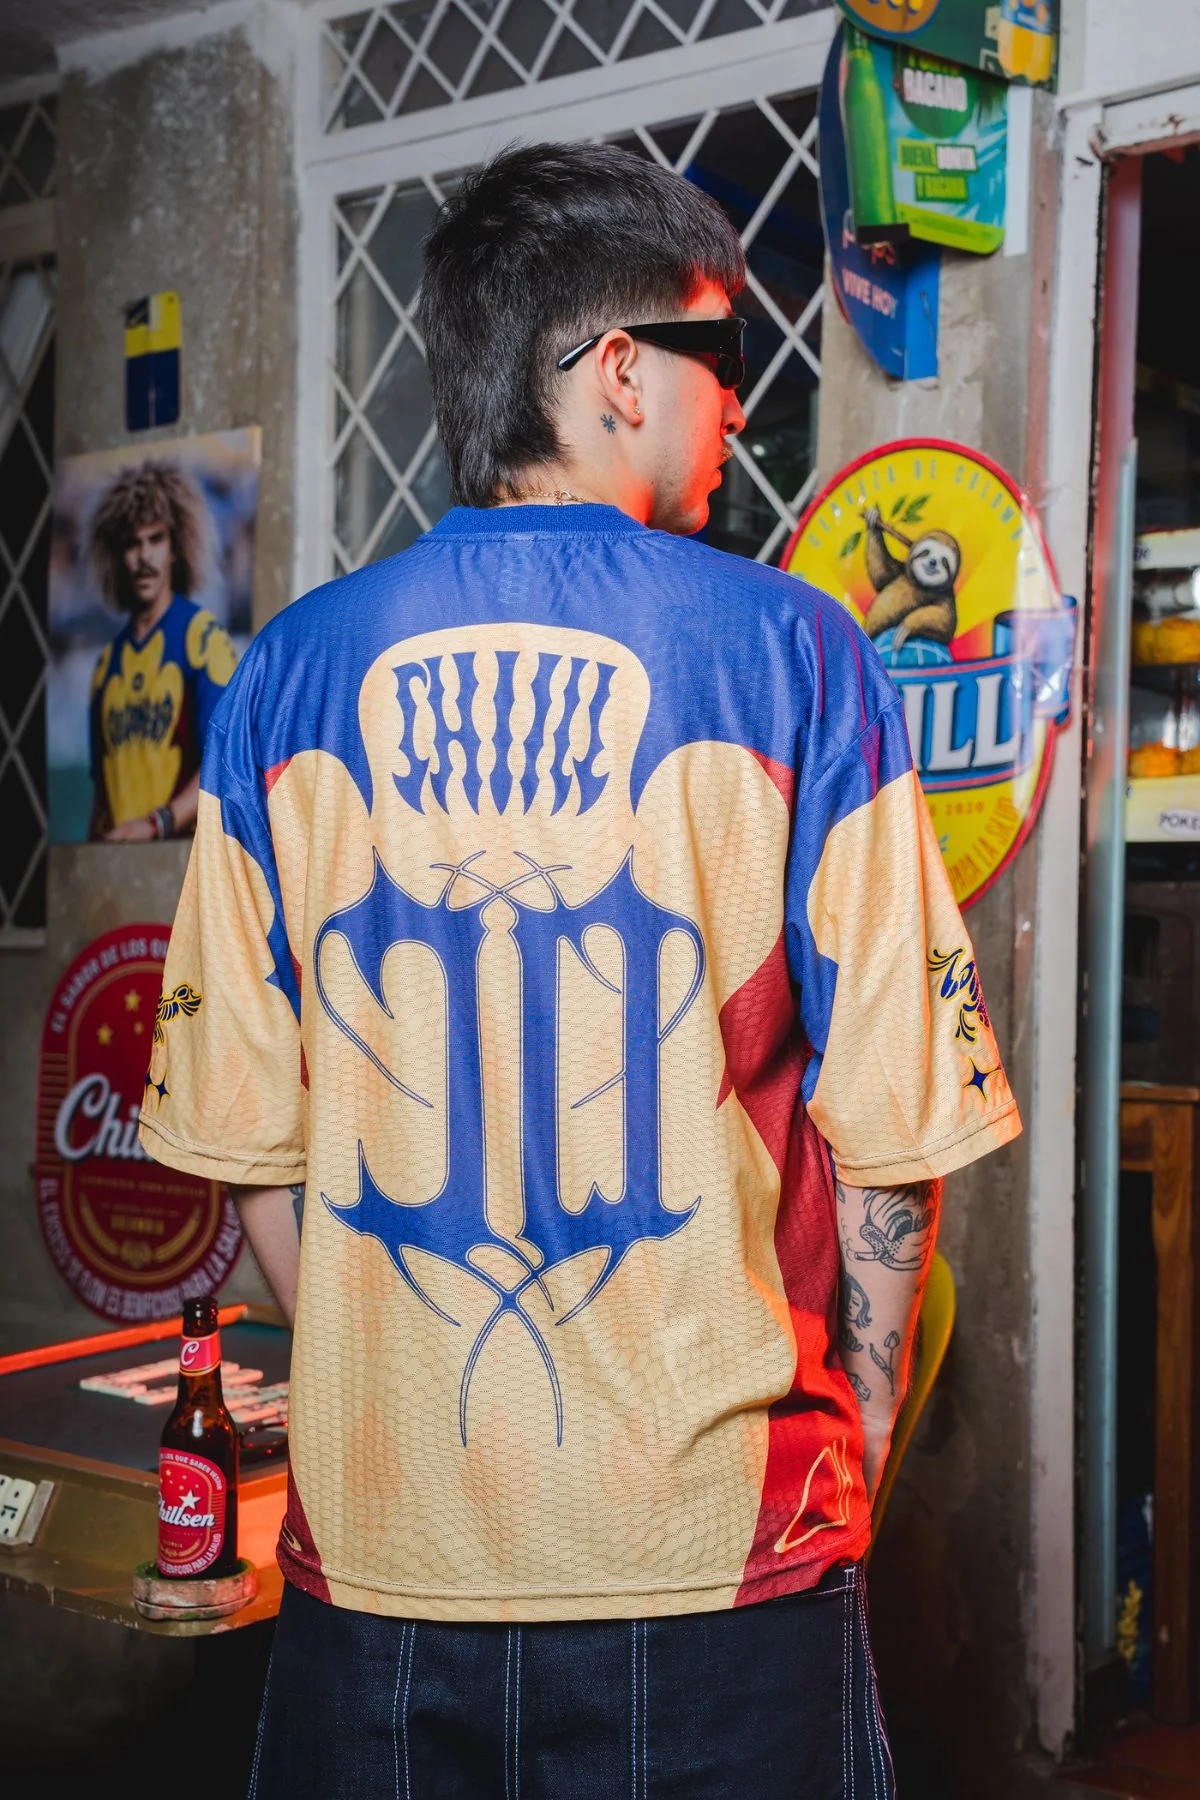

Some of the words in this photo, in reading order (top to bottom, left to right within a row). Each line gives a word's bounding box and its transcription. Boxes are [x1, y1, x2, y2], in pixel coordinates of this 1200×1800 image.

[1159, 812, 1200, 831] POKE
[150, 938, 169, 960] QU
[180, 1340, 200, 1366] C
